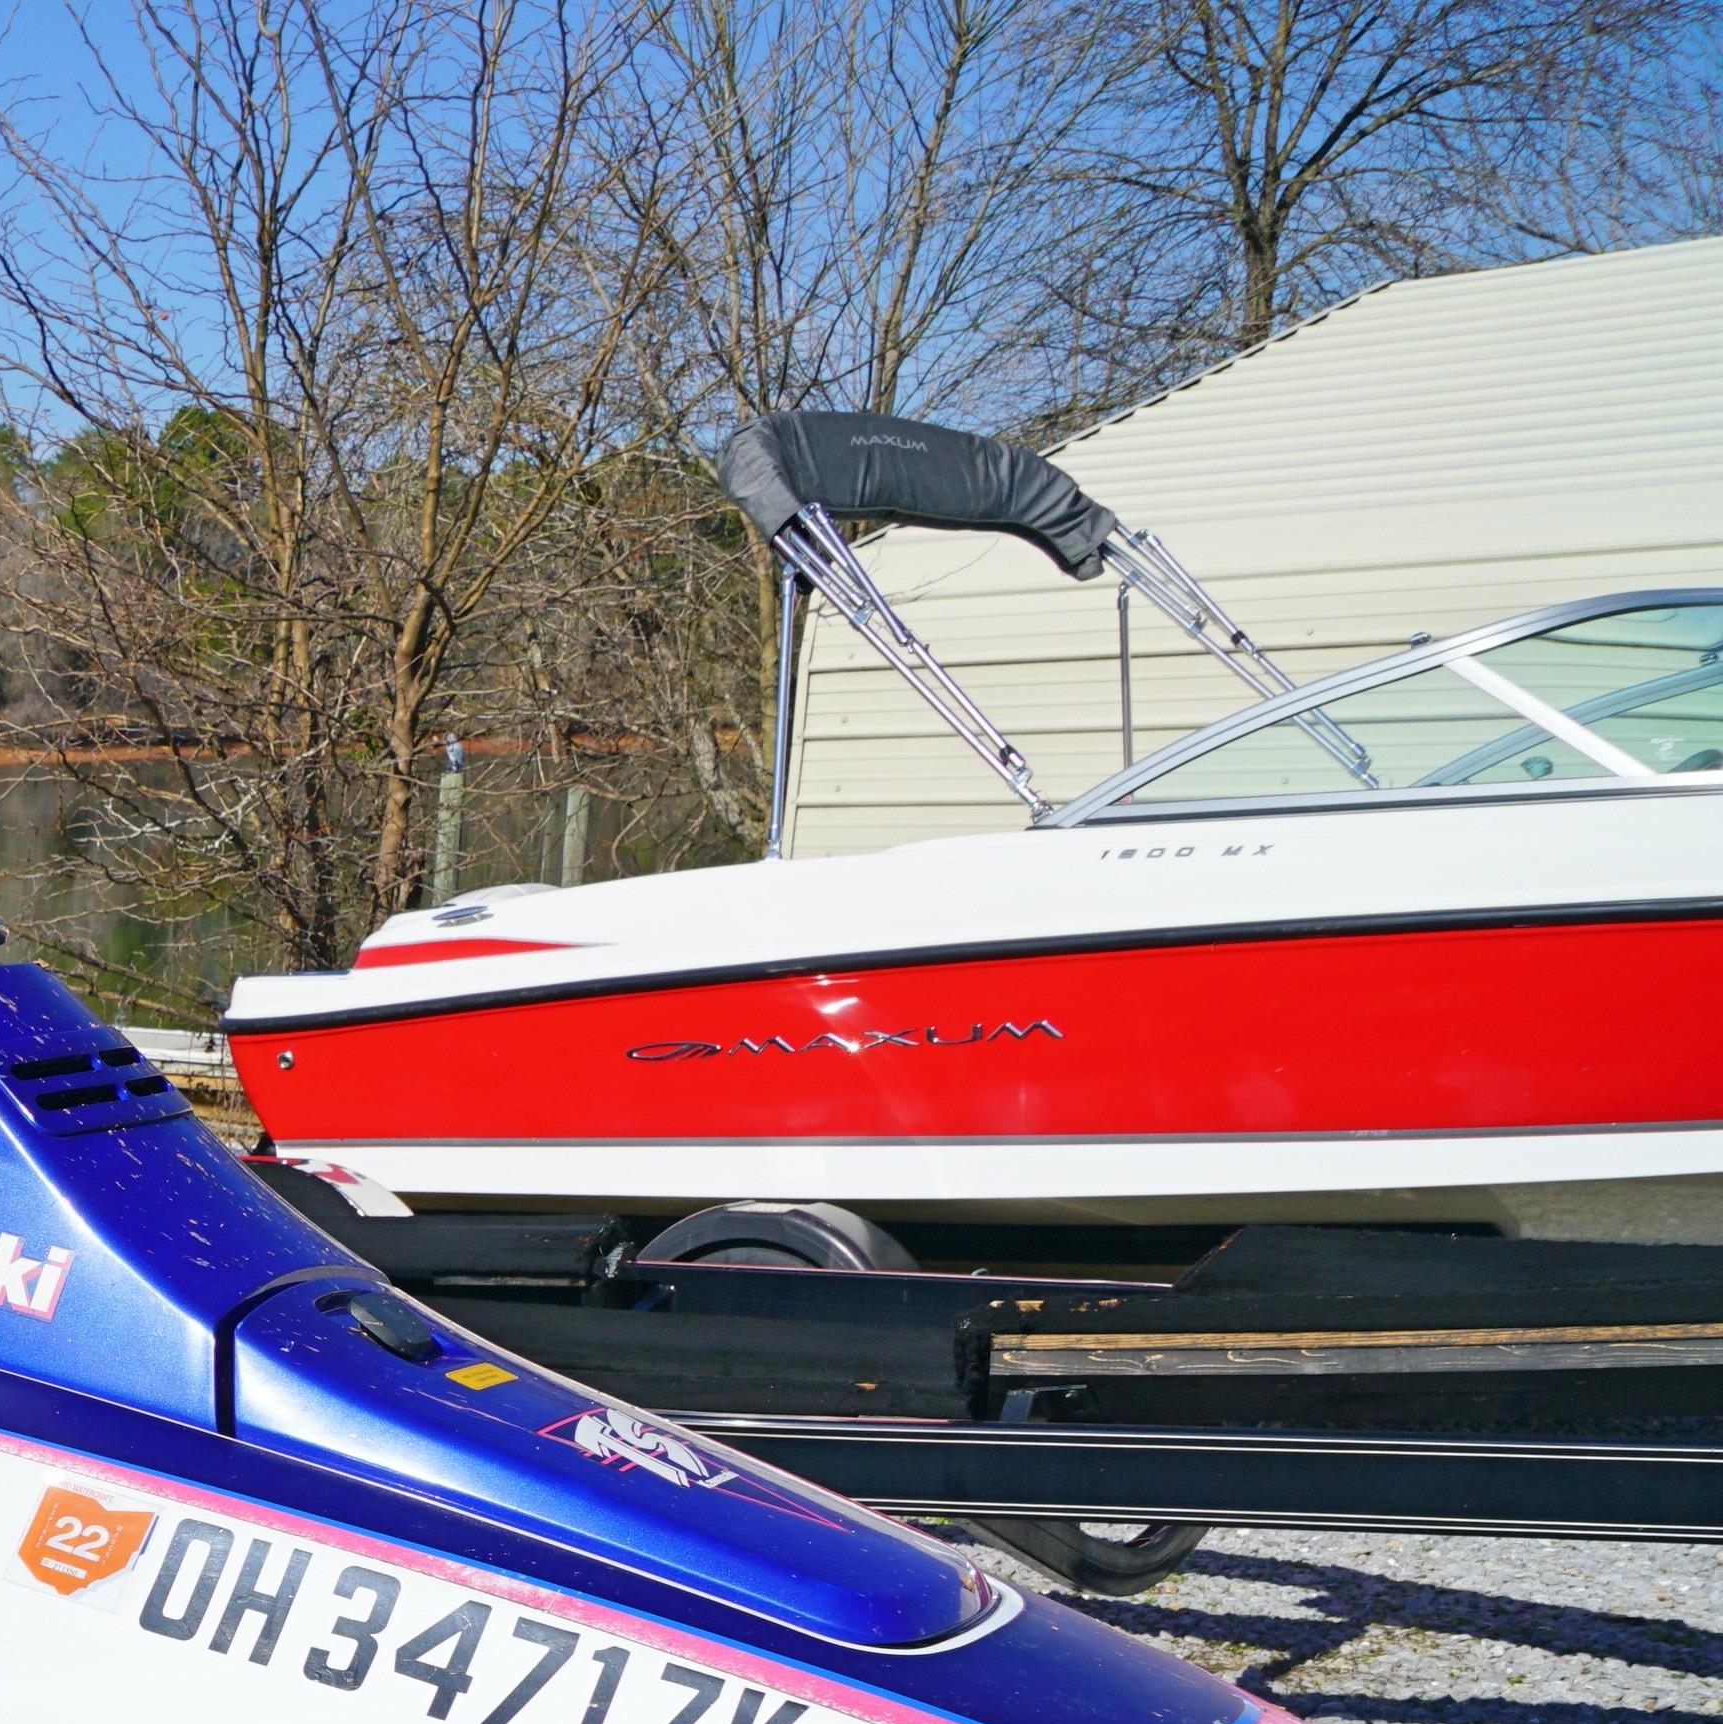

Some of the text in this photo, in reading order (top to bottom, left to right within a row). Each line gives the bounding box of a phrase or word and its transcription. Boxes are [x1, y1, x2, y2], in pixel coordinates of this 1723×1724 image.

[850, 434, 928, 453] MAXUM
[1221, 845, 1275, 857] MX
[728, 1018, 1065, 1055] MAXUM
[46, 1515, 109, 1563] 22
